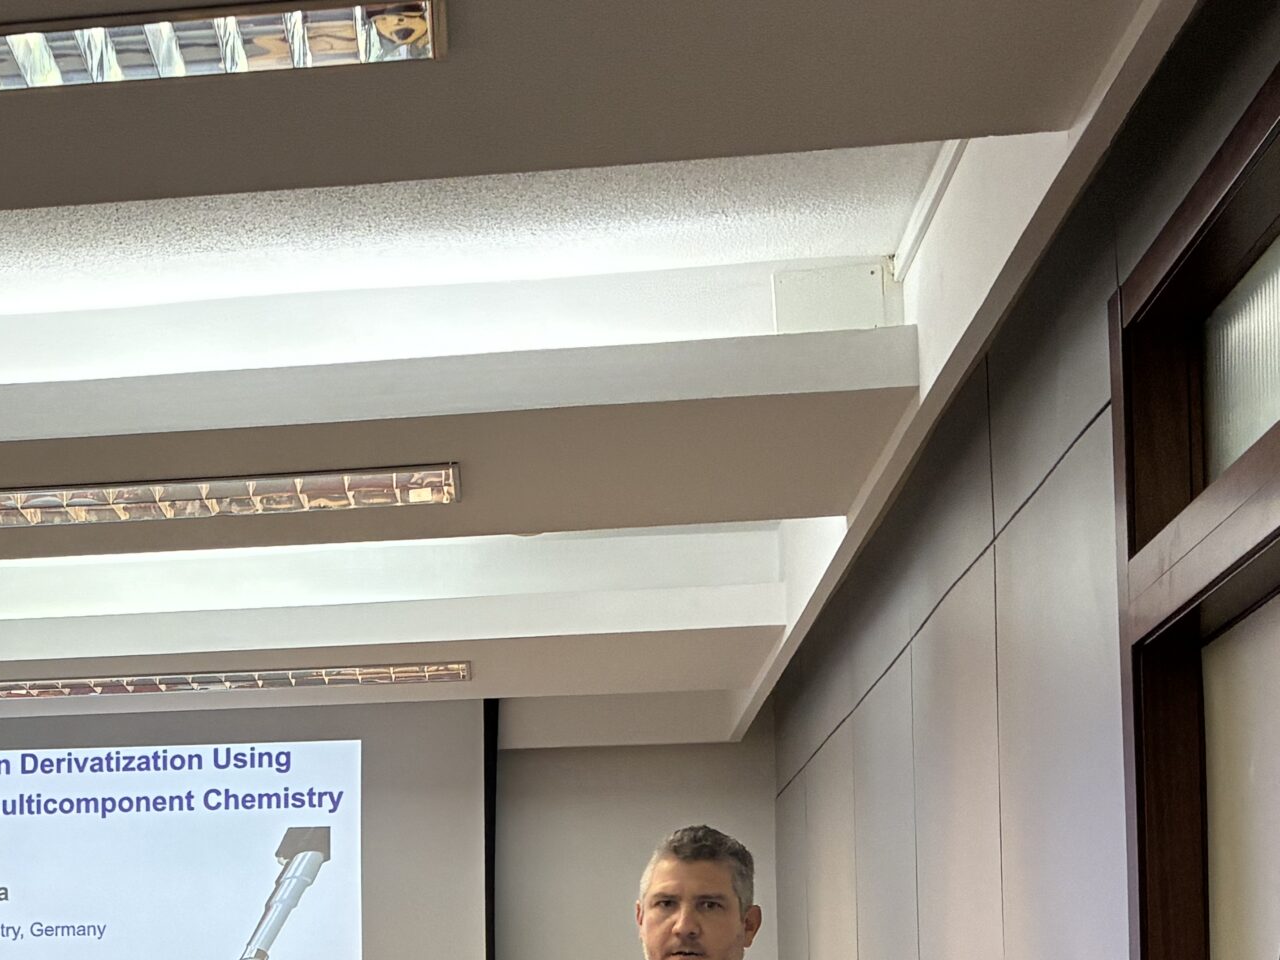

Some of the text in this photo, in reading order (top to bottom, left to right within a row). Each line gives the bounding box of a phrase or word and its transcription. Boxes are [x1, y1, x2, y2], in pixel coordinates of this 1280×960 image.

[21, 750, 203, 775] Derivatization
[214, 747, 291, 773] Using
[203, 787, 344, 813] Chemistry
[30, 922, 107, 940] Germany
